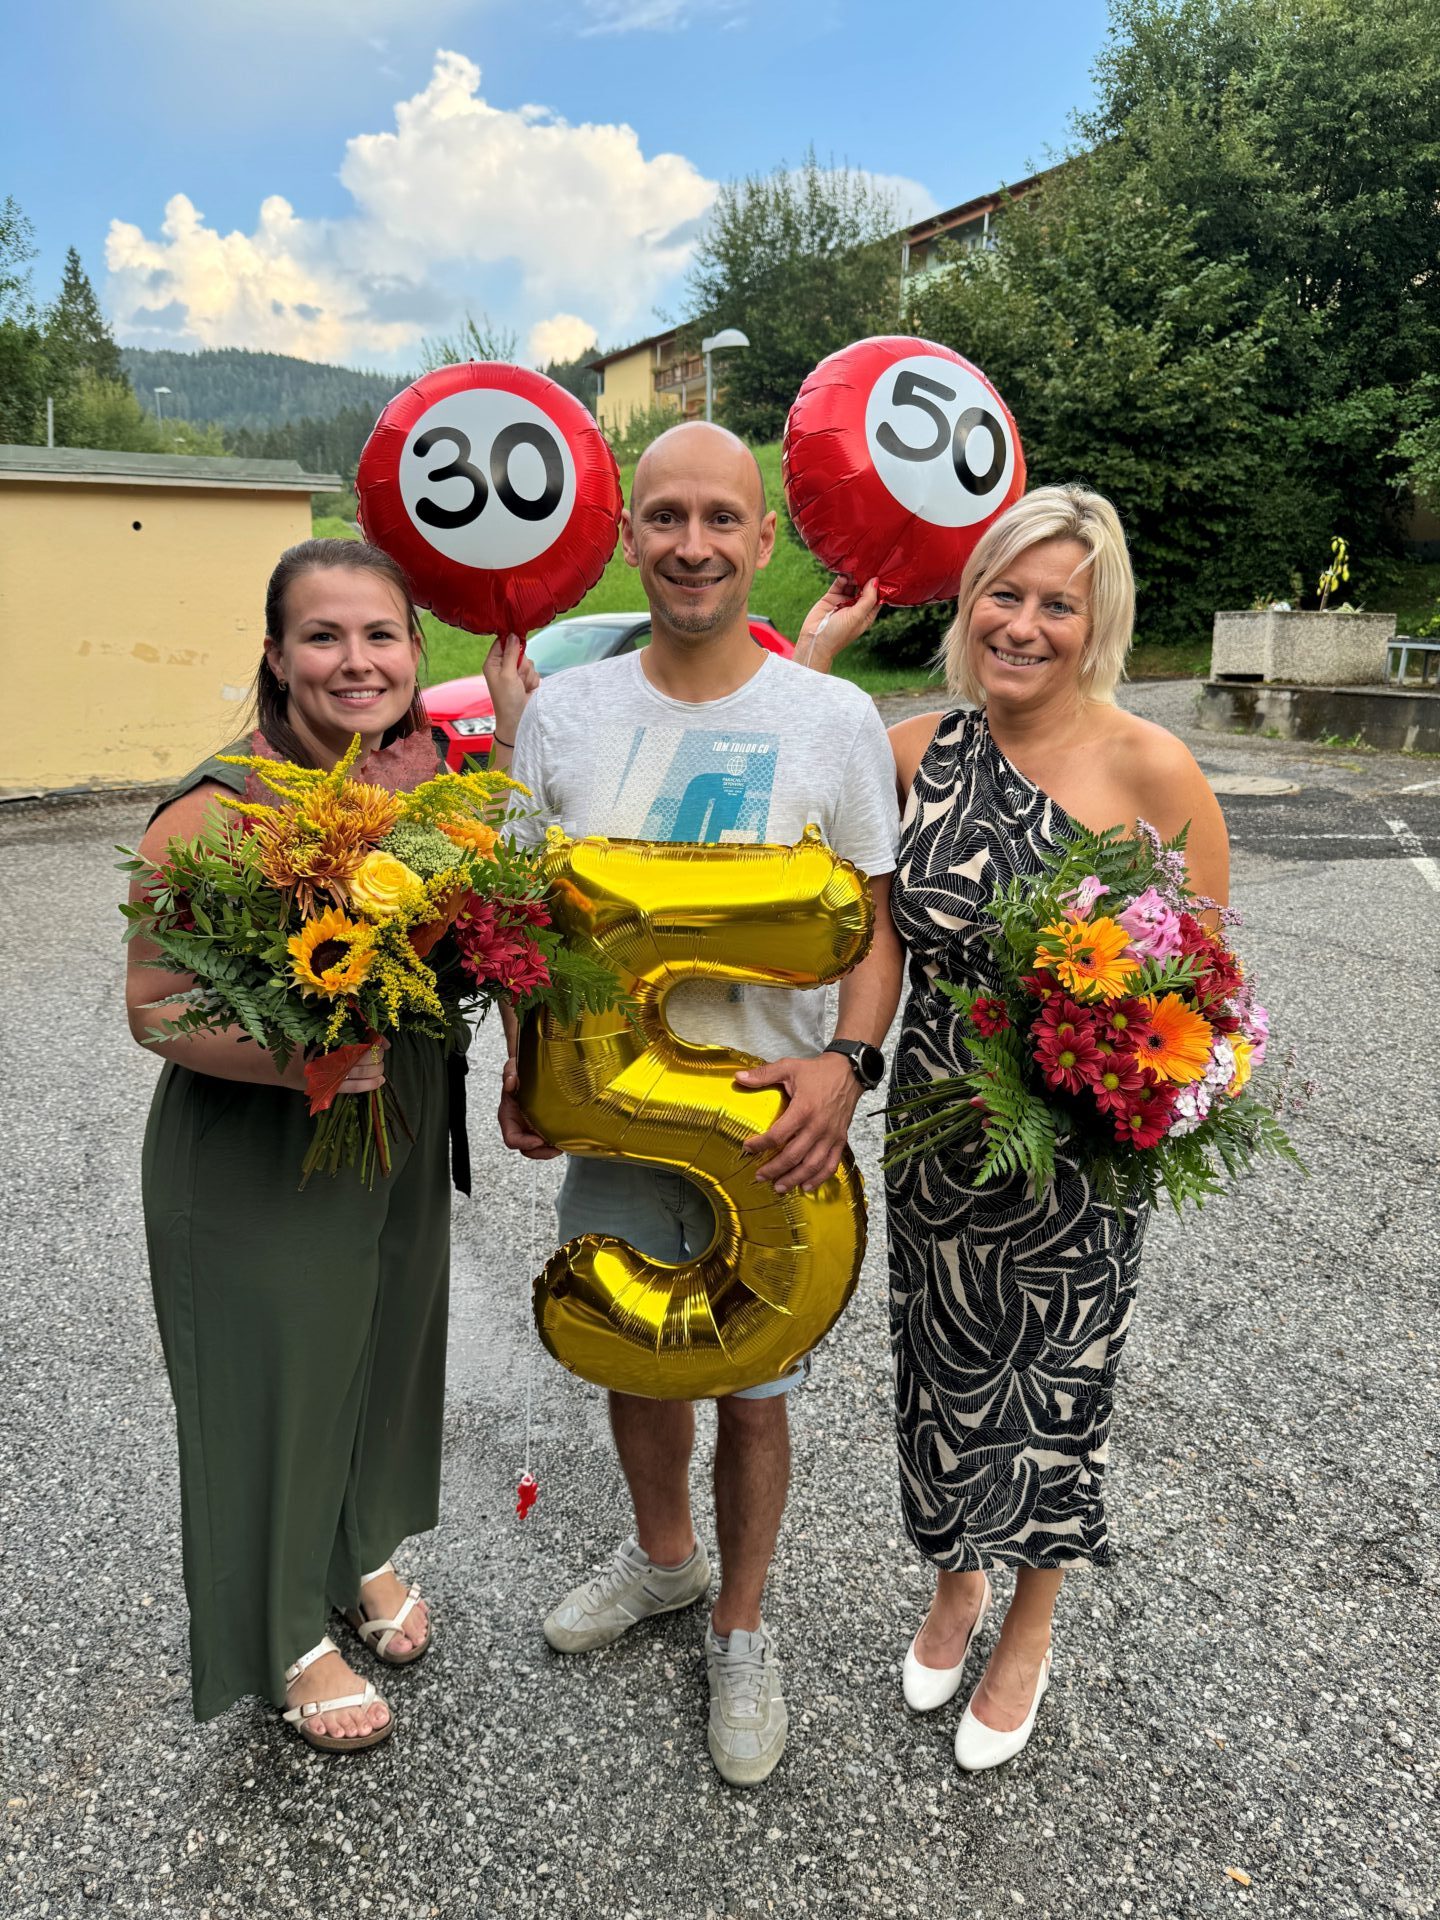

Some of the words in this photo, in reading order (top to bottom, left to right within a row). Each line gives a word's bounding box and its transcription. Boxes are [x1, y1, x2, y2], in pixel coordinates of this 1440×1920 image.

[413, 422, 565, 529] 30
[875, 370, 1007, 496] 50
[712, 741, 729, 752] TOM
[730, 743, 757, 753] TAILOR
